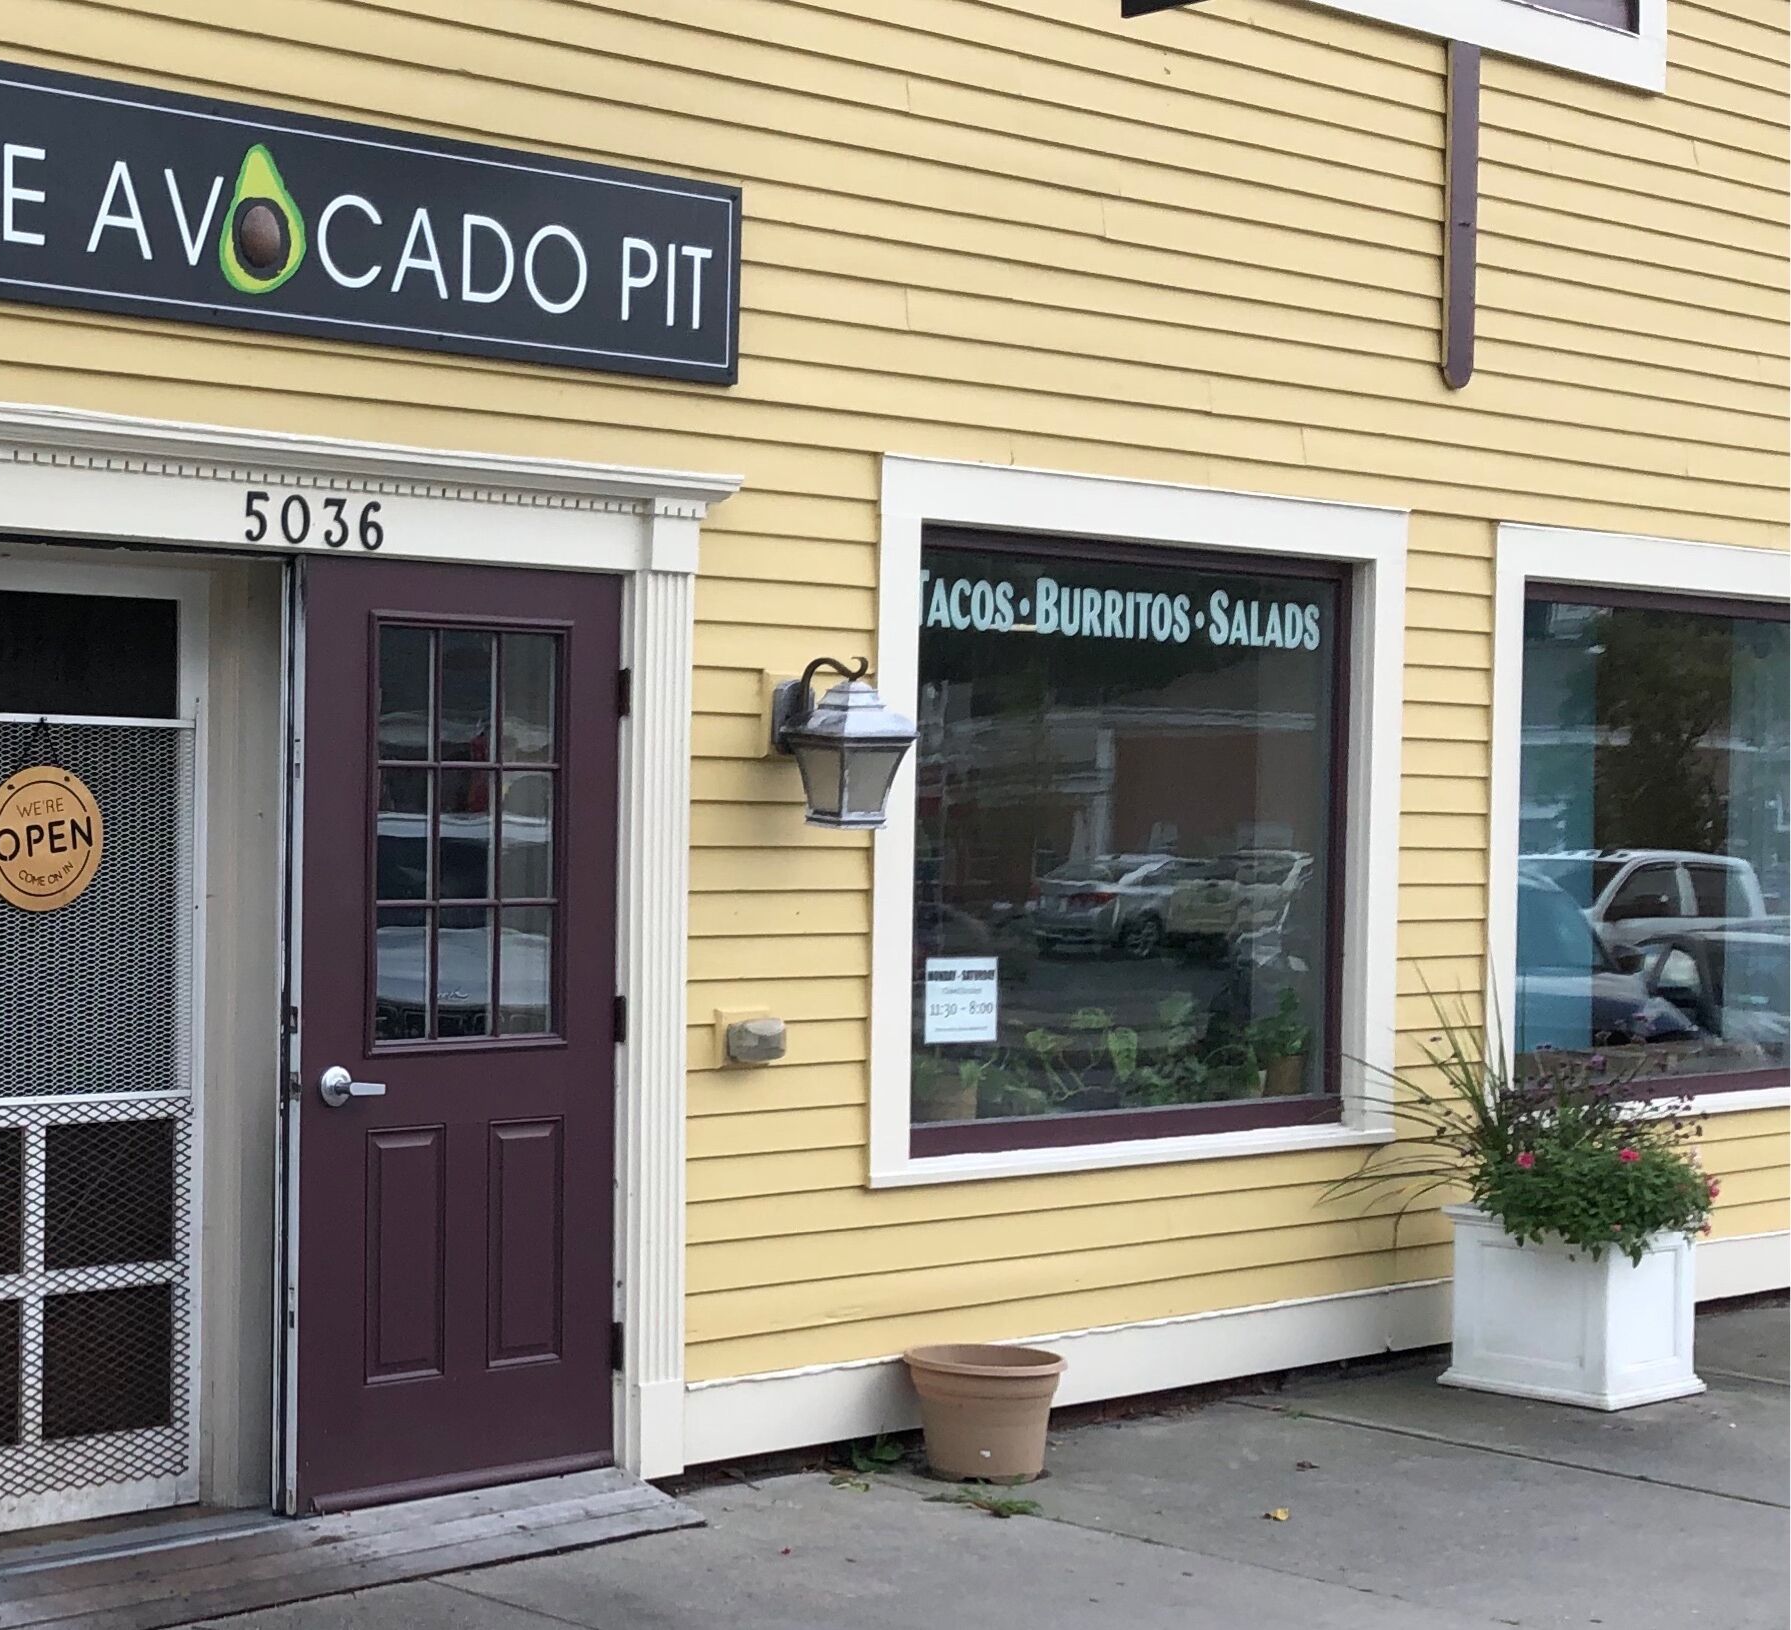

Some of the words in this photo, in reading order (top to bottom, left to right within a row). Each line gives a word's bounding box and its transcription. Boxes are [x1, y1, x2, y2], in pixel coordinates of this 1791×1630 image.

[621, 236, 714, 331] PIT
[245, 490, 384, 551] 5036
[1035, 577, 1191, 644] BURRITOS
[1209, 590, 1321, 651] SALADS
[16, 798, 65, 819] WE'RE
[18, 869, 45, 887] COME
[48, 870, 63, 885] ON
[62, 860, 74, 875] IN
[929, 1003, 958, 1018] 11:30
[969, 1001, 994, 1015] 8:00
